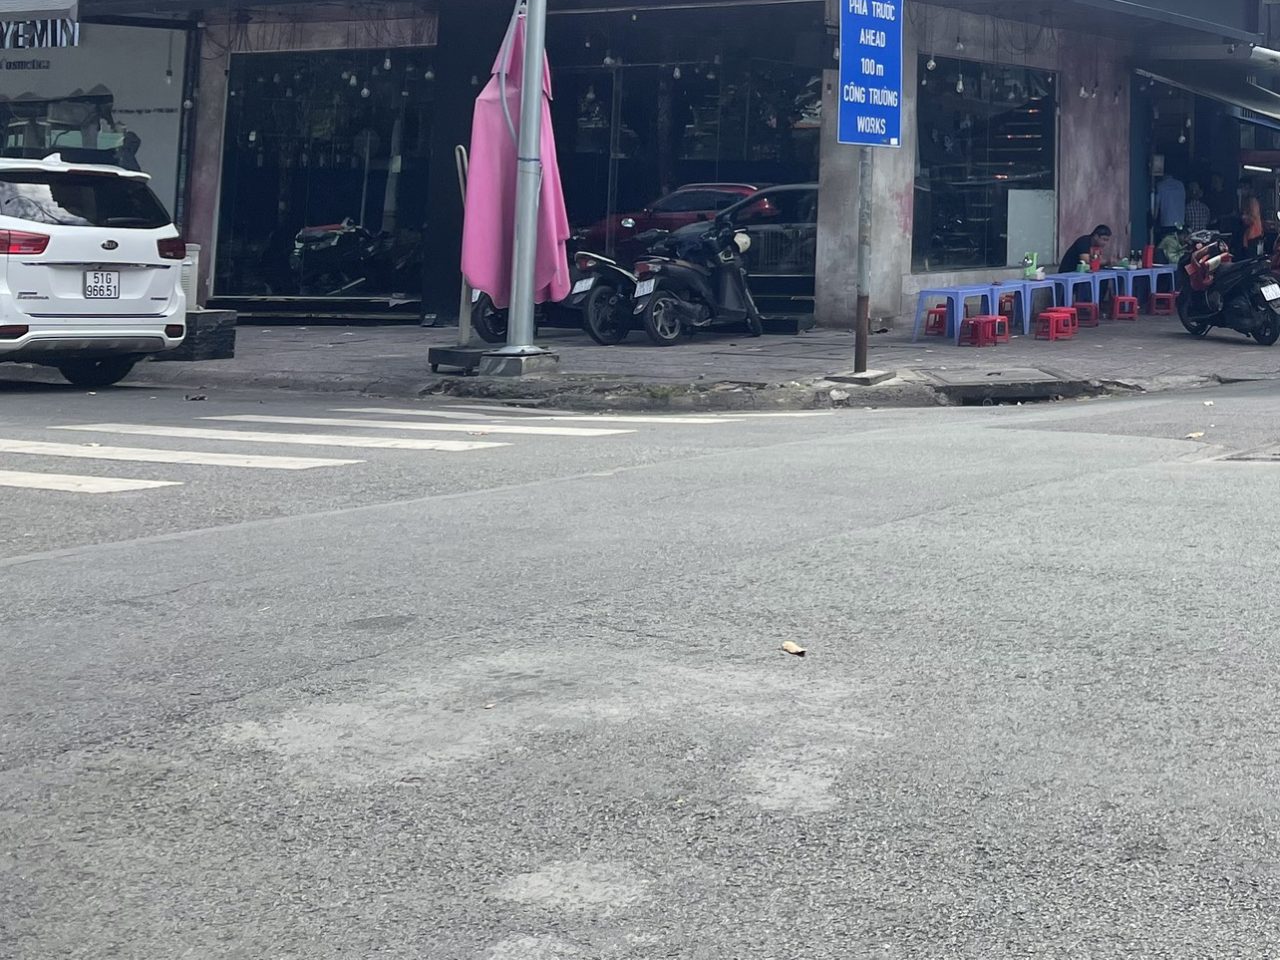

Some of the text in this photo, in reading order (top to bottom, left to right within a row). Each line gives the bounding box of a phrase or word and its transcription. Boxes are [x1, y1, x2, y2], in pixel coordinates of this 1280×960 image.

[859, 28, 886, 48] AHEAD
[843, 81, 866, 103] CÔNG
[857, 116, 886, 135] WORKS
[93, 272, 112, 284] 51G
[86, 285, 118, 298] 966.51
